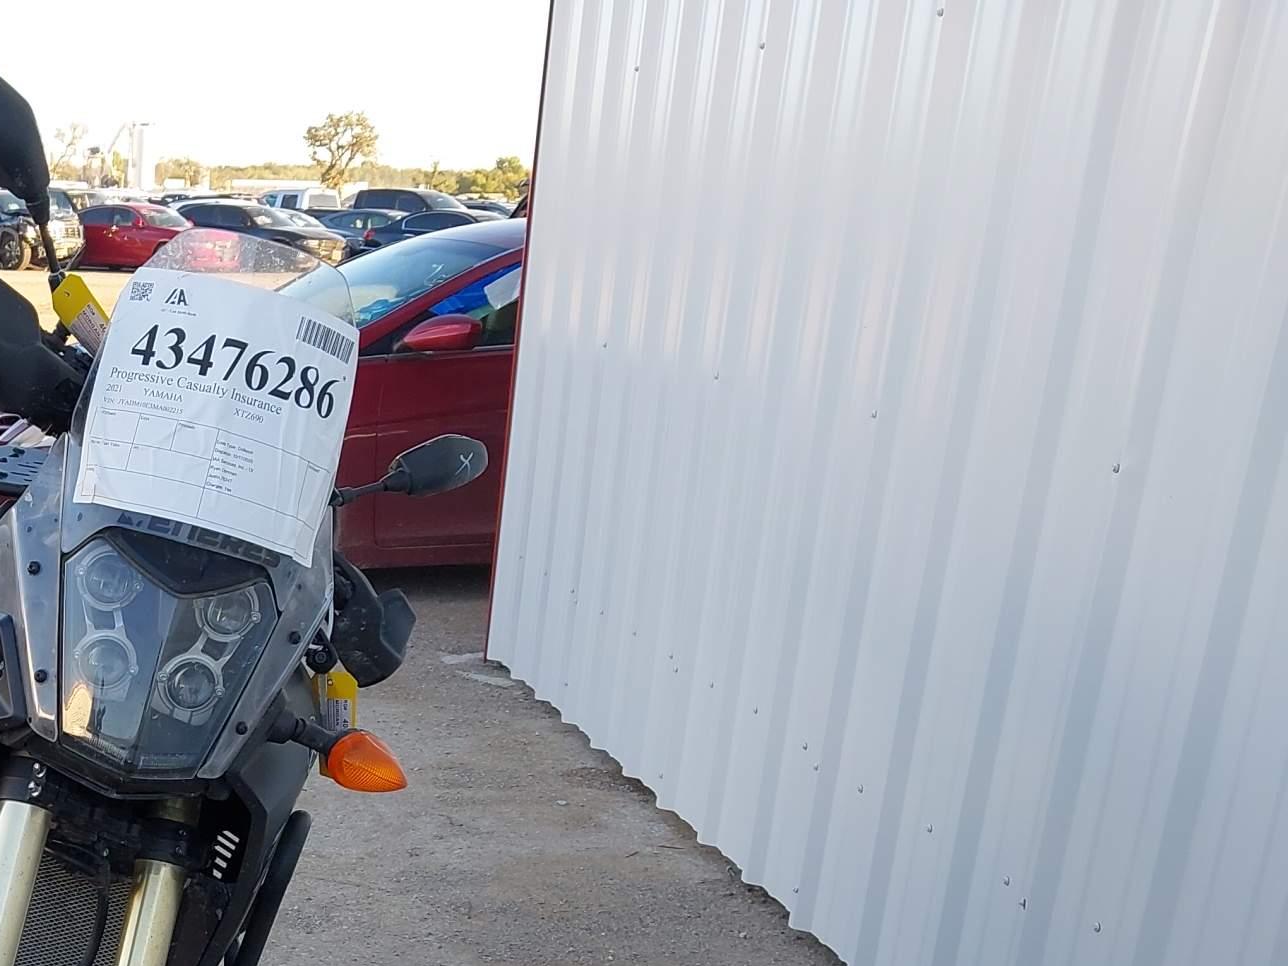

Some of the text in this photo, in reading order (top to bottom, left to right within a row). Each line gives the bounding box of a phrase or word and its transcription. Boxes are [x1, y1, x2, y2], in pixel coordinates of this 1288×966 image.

[109, 367, 283, 415] Progressive Casualty Insurance
[130, 324, 340, 419] 43476286
[105, 383, 264, 424] 2021 YAMAHA XTZ690
